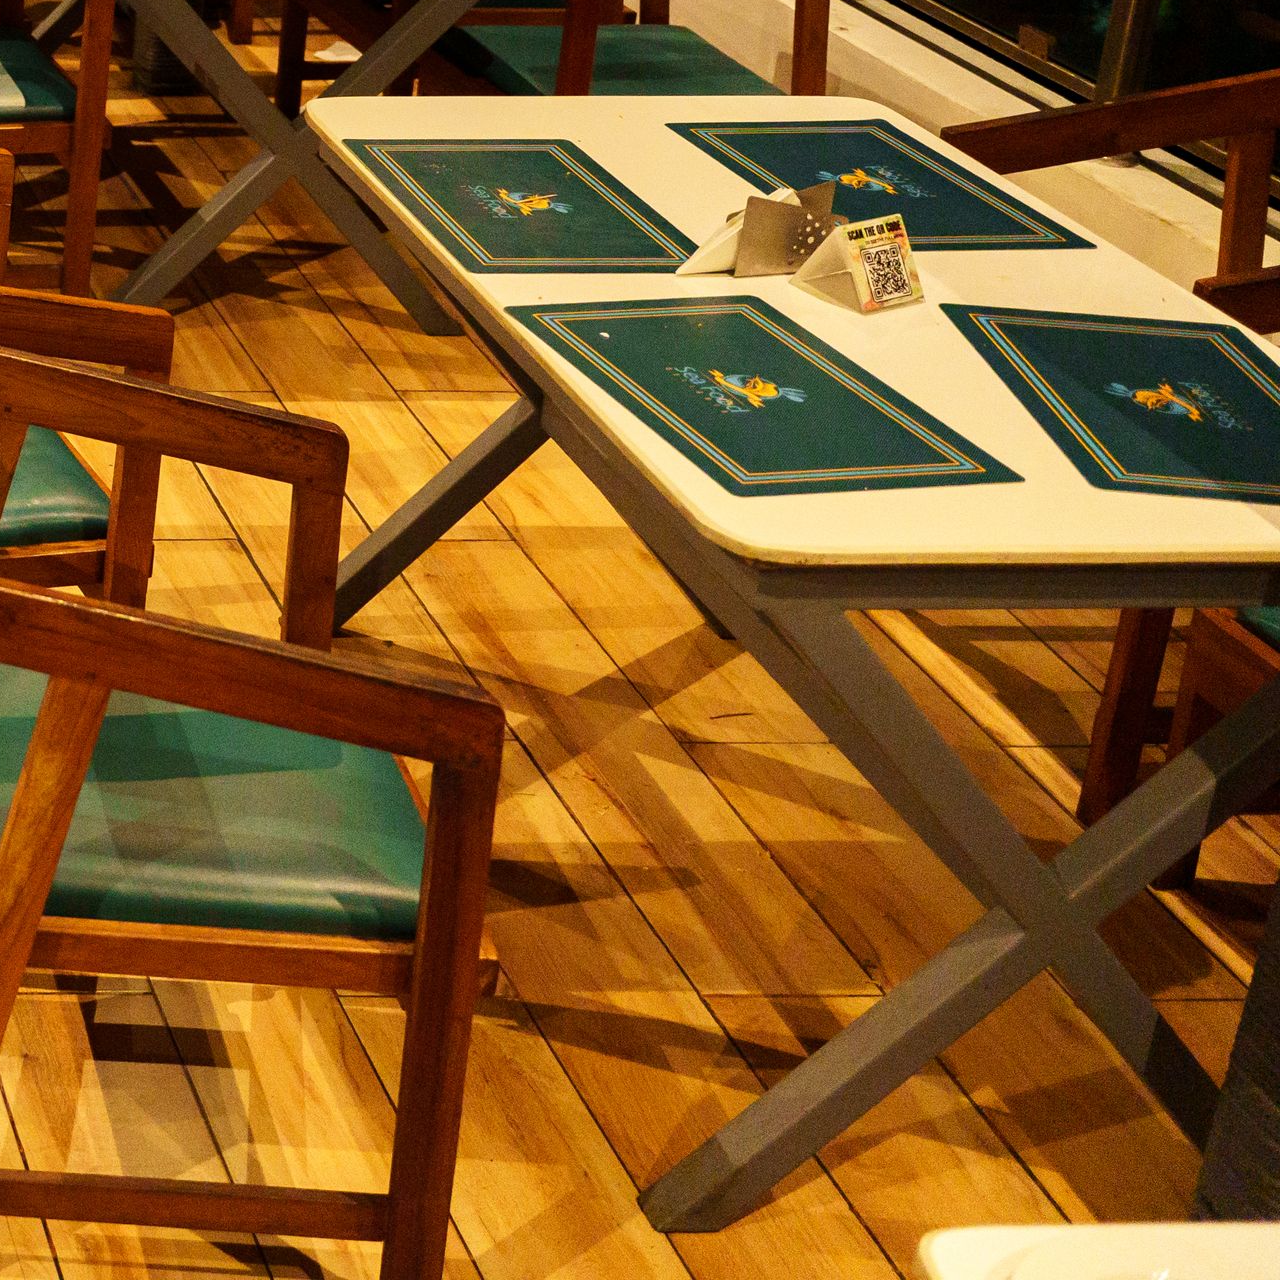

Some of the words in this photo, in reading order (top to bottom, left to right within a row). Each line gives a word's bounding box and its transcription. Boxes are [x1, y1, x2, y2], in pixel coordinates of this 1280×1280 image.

[847, 228, 864, 241] SCAN
[864, 226, 876, 237] THE
[876, 224, 886, 235] QR
[885, 220, 902, 232] CODE
[674, 366, 707, 385] Sea
[700, 385, 752, 413] Food
